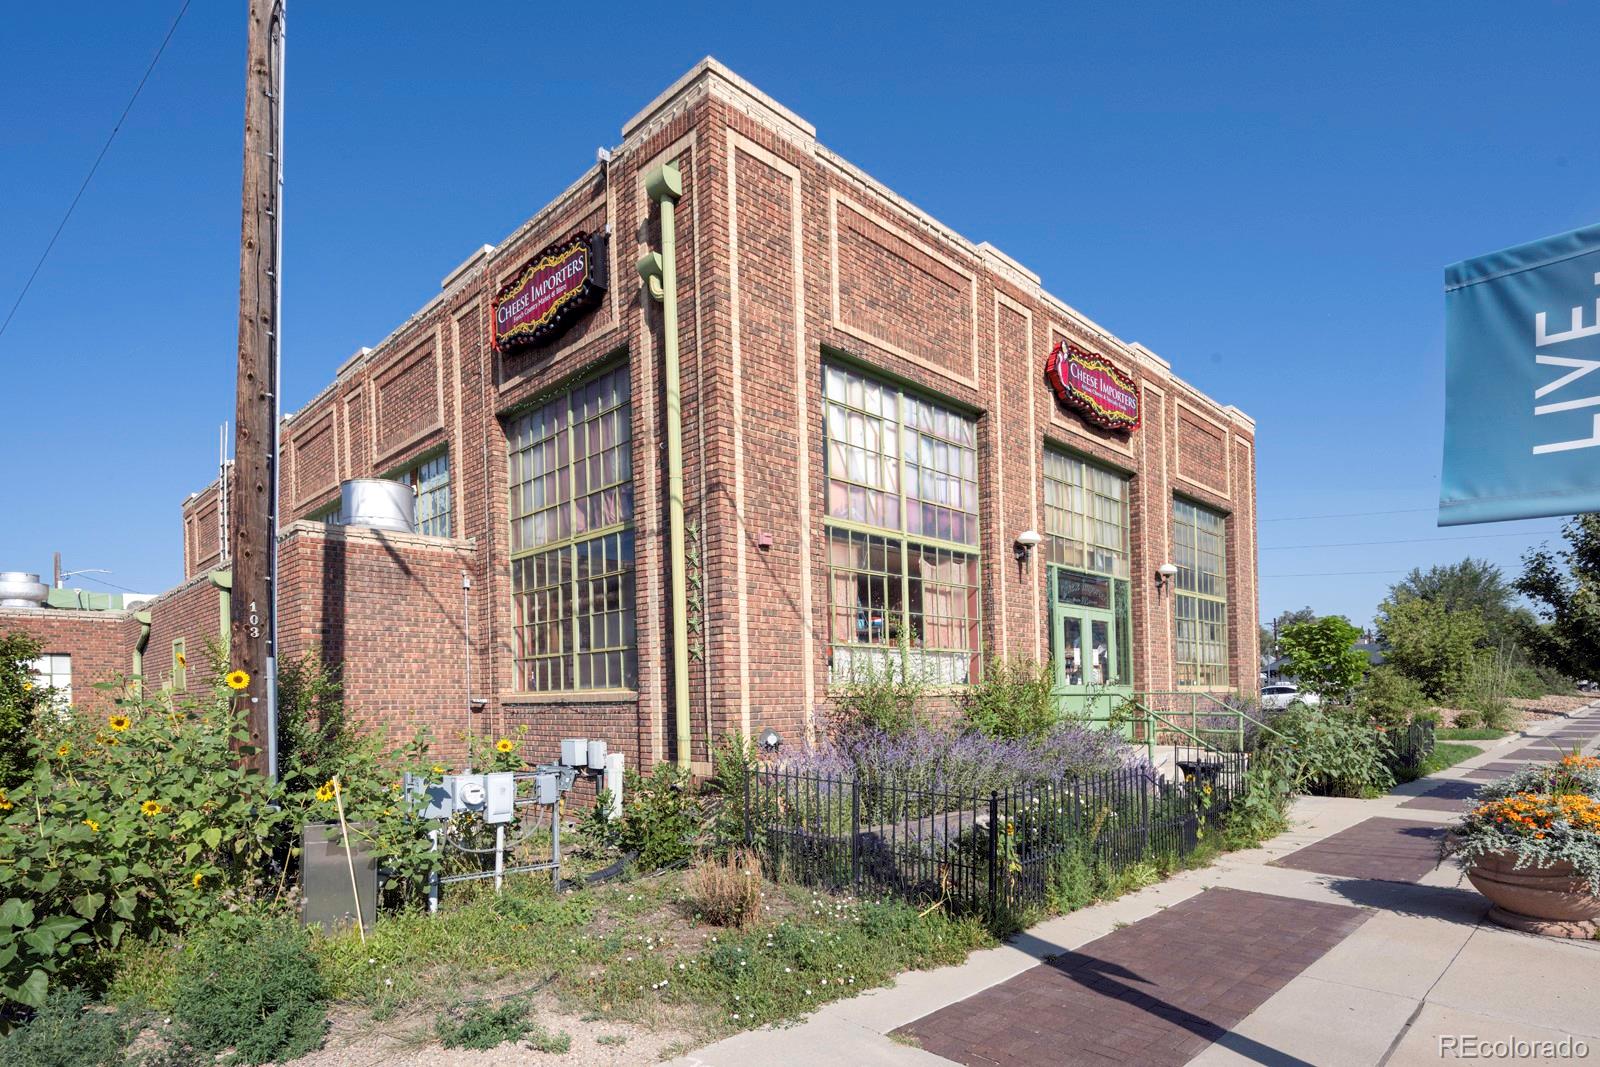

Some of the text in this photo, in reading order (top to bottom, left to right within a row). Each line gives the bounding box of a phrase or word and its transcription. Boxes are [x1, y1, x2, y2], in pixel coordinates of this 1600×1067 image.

[498, 255, 584, 323] CHEESE IMPORTERS
[513, 311, 525, 323] French
[524, 303, 538, 315] Country
[538, 294, 551, 306] Market
[1070, 363, 1098, 389] CHEESE
[1100, 378, 1136, 409] IMPORTERS
